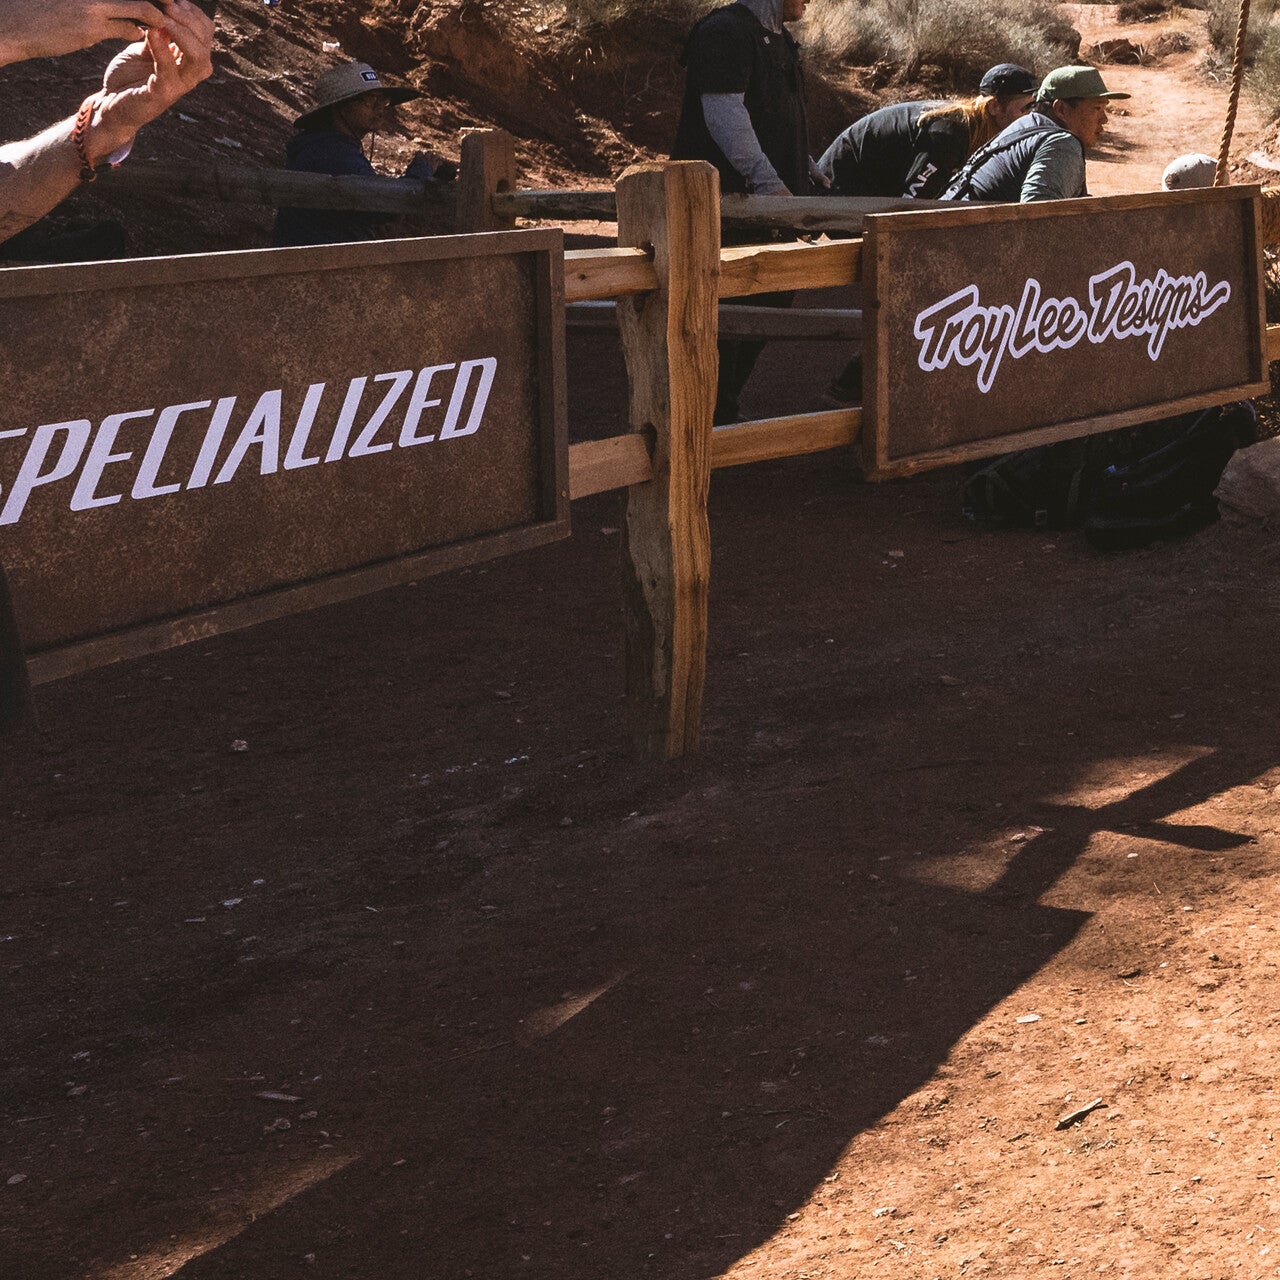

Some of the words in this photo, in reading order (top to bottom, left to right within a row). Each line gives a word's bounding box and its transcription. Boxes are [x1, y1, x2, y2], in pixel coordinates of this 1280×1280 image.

[914, 284, 1018, 394] Troy
[1009, 277, 1088, 360] Lee
[1087, 260, 1231, 361] Designs
